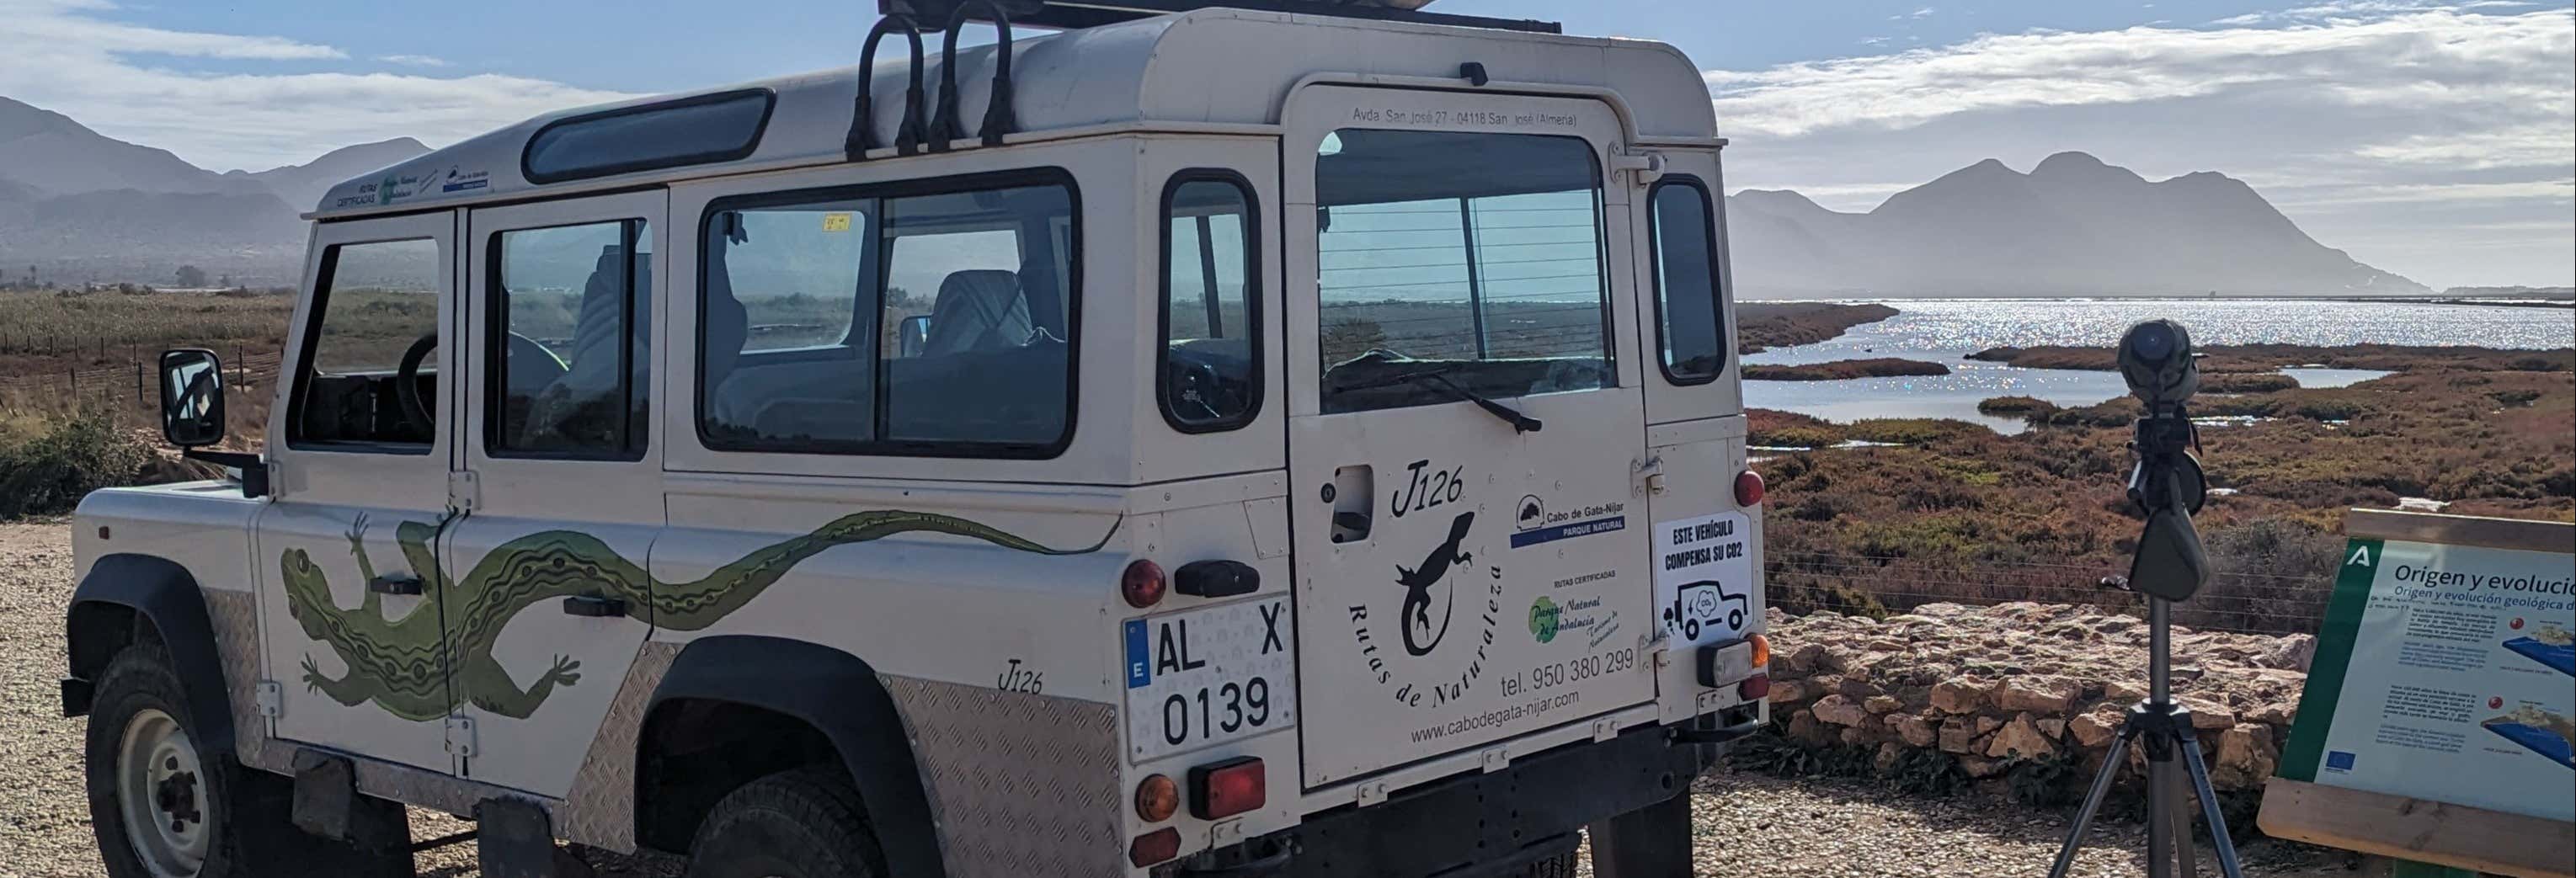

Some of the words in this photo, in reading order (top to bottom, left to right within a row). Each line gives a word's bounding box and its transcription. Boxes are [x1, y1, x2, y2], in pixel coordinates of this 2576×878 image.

[1386, 109, 1406, 122] San
[1457, 111, 1486, 125] 04118
[1489, 112, 1508, 125] San
[1391, 460, 1464, 519] J126
[1547, 512, 1569, 523] Cabo
[1571, 509, 1582, 519] de
[1563, 524, 1591, 537] PARQUE
[1592, 519, 1624, 532] NATURAL
[1673, 526, 1693, 545] ESTE
[1695, 519, 1733, 541] VEHÍCULO
[1665, 547, 1711, 571] COMPENSA
[1713, 545, 1724, 561] SU
[1554, 578, 1574, 588] RUTAS
[1575, 570, 1616, 585] CERTIFICADAS
[2395, 565, 2465, 588] Origen
[2471, 573, 2484, 590] y
[1533, 605, 1564, 622] Parque
[1565, 596, 1601, 616] Natural
[2395, 586, 2433, 601] Origen
[2435, 592, 2443, 600] y
[2445, 592, 2501, 604] evolución
[2504, 595, 2563, 611] geológica
[1157, 620, 1205, 676] AL
[1260, 602, 1283, 654] X
[1349, 602, 1391, 684] Rutas
[1395, 683, 1421, 707] de
[1432, 565, 1502, 709] Naturaleza
[998, 659, 1044, 695] J126
[1133, 662, 1144, 678] E
[1501, 676, 1528, 697] tel.
[1533, 668, 1564, 690] 950
[1570, 655, 1600, 681] 380
[1606, 648, 1634, 674] 299
[1164, 677, 1269, 745] 0139
[1411, 689, 1580, 743] www.cabodegata-nijar.com
